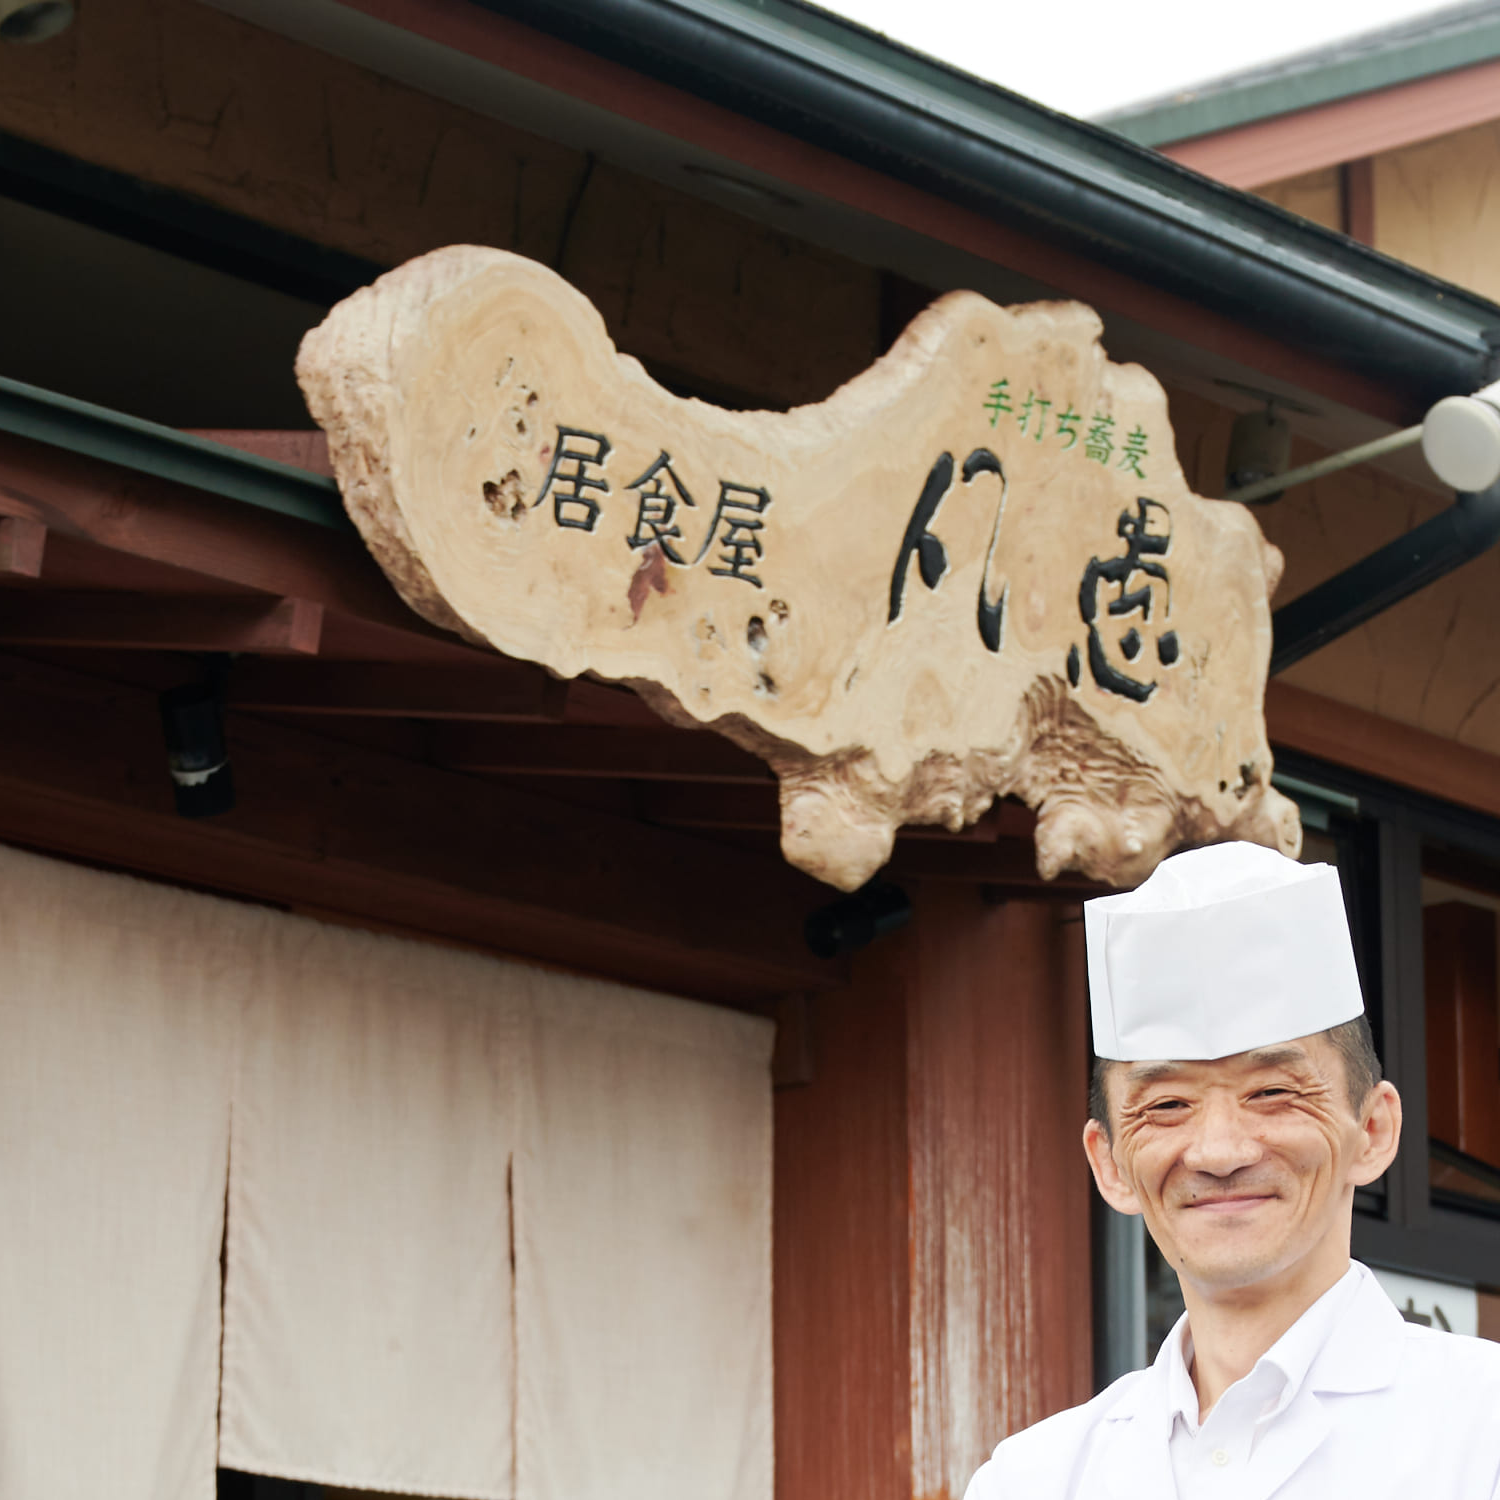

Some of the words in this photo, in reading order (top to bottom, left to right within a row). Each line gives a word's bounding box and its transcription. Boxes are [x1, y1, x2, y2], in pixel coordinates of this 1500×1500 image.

[983, 379, 1150, 480] 手打ち蕎麦
[535, 425, 773, 588] 居食屋
